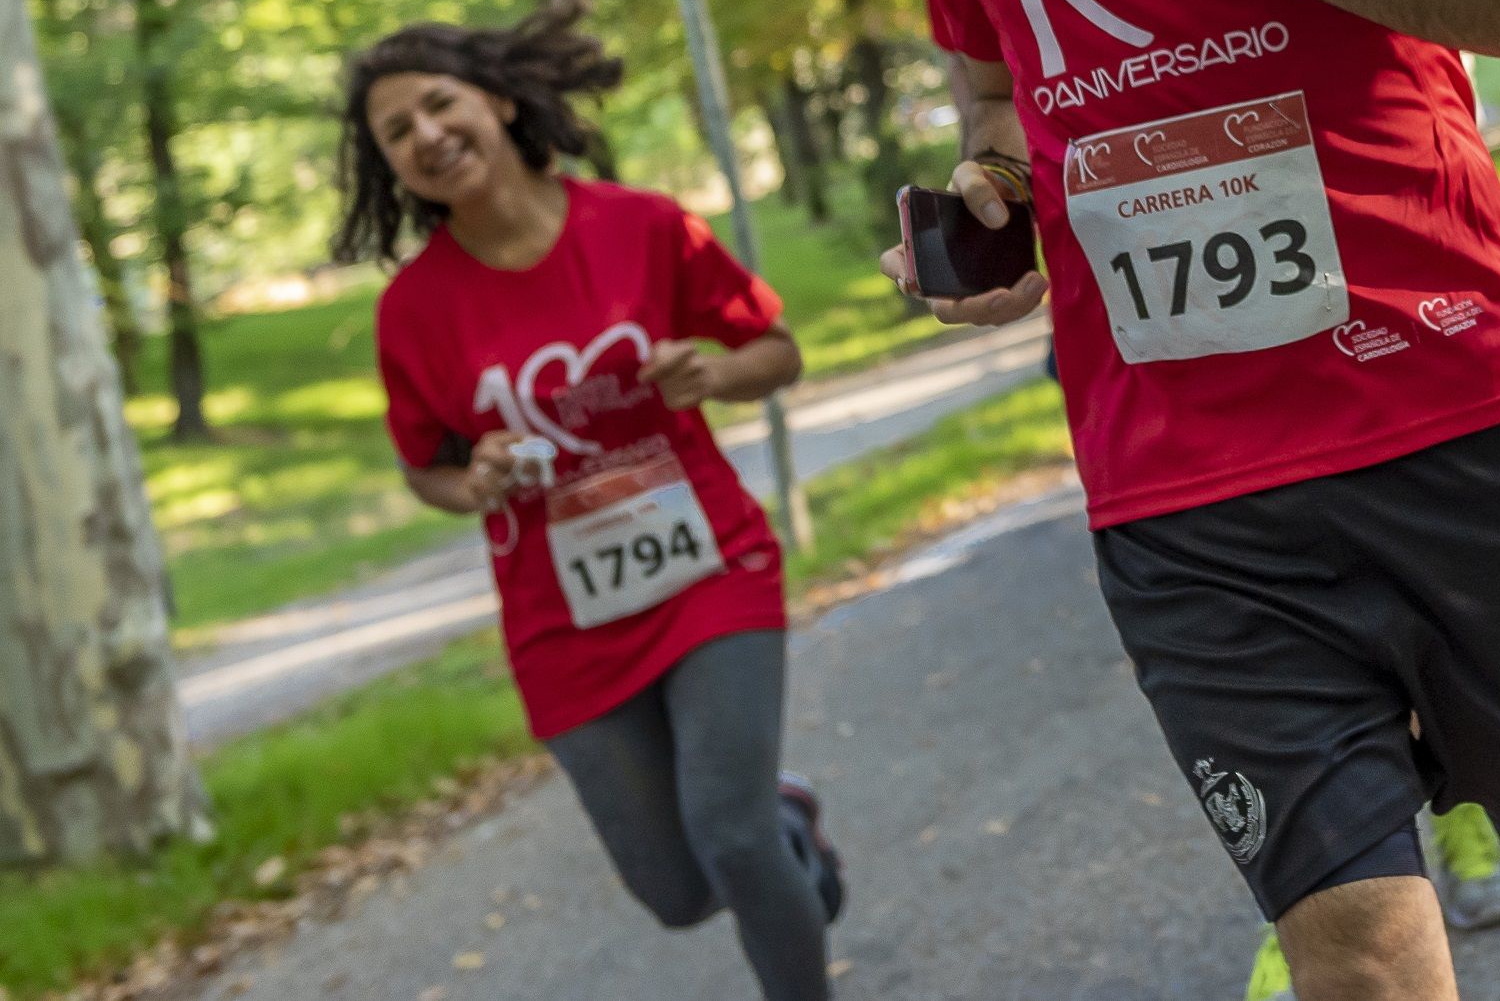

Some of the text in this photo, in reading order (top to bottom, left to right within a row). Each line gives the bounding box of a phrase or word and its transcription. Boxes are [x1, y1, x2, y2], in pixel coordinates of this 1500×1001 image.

[1055, 21, 1290, 109] ANIVERSARIO
[1118, 173, 1261, 218] CARRERA 10K
[1110, 219, 1316, 320] 1793
[569, 520, 701, 597] 1794
